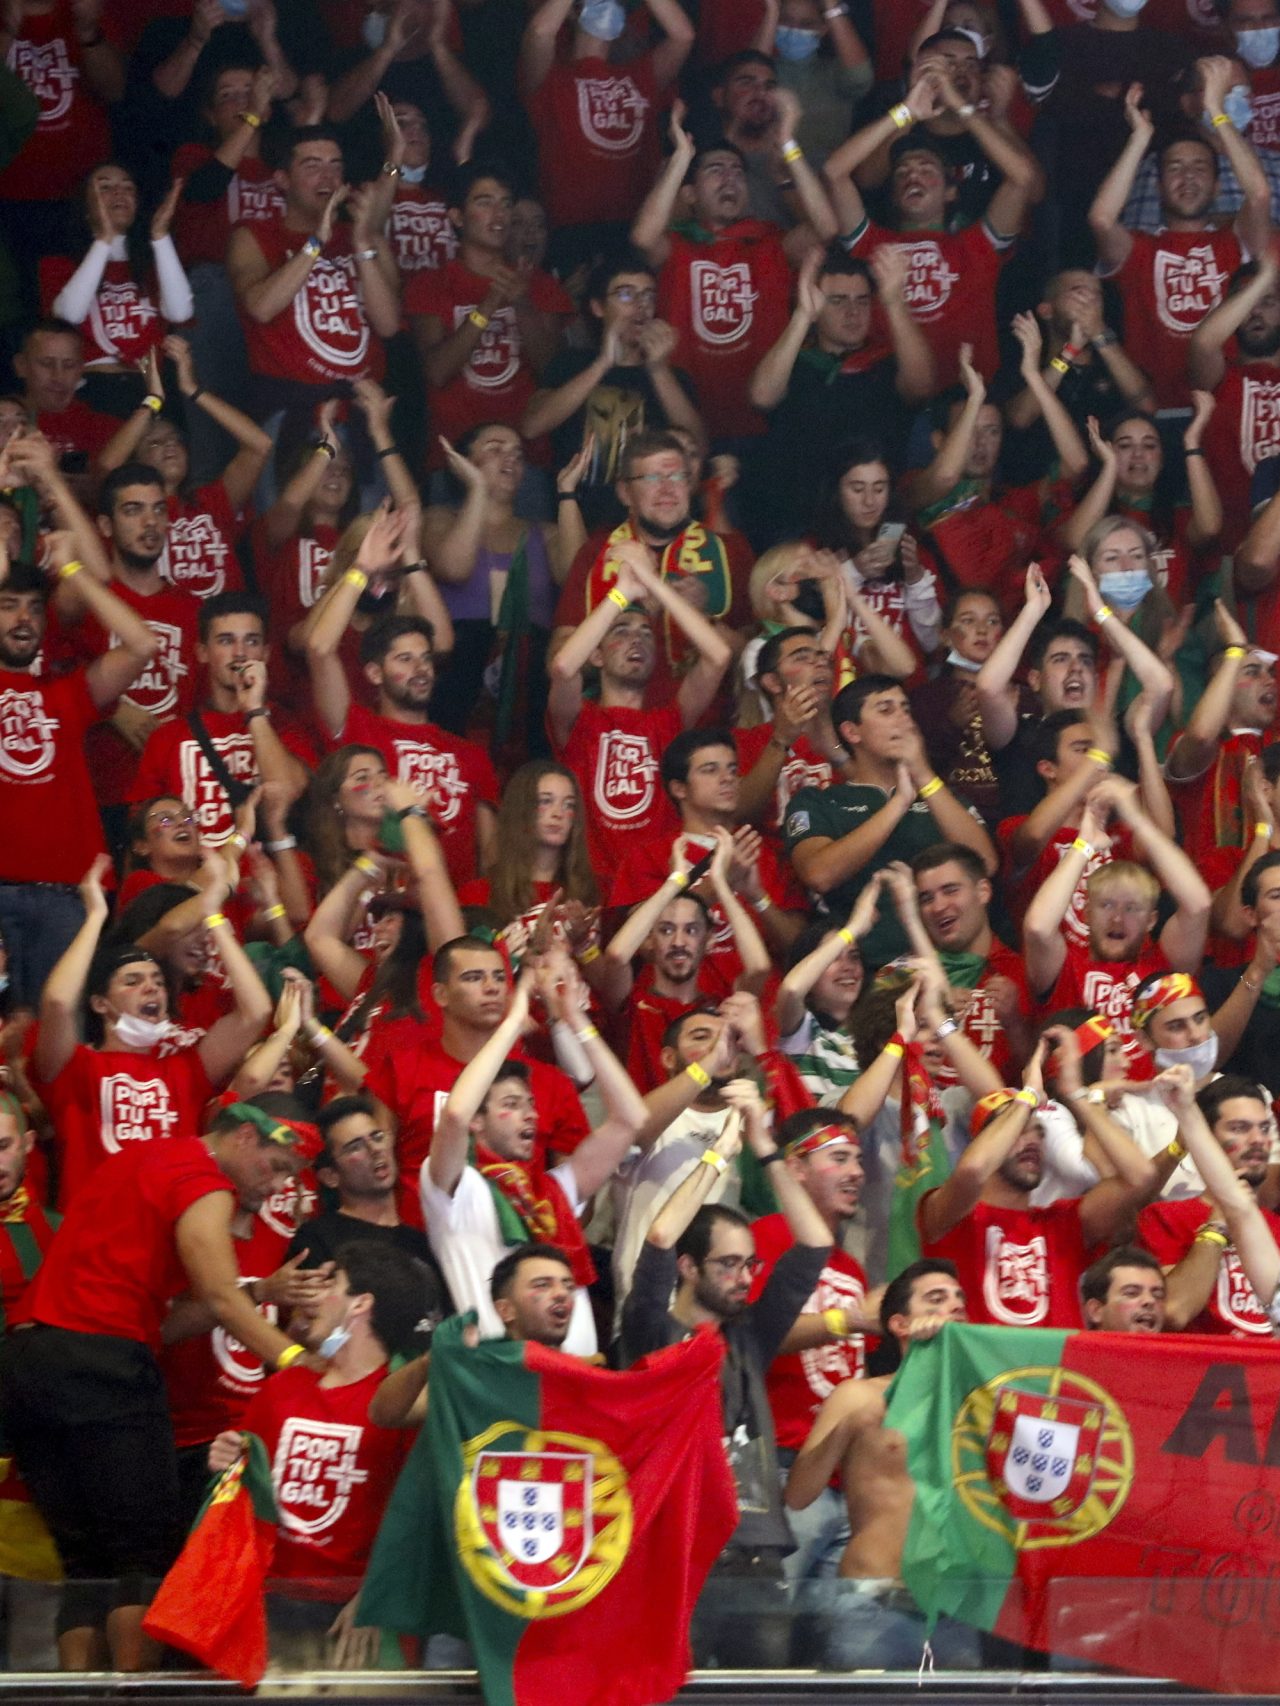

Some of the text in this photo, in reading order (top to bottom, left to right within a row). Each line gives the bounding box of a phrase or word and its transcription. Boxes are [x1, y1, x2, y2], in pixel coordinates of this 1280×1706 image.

[1168, 279, 1194, 293] TU
[702, 288, 729, 304] TU
[1167, 294, 1210, 313] GAL
[702, 306, 740, 322] GAL
[171, 544, 202, 560] TU
[606, 779, 644, 797] GAL
[116, 1104, 145, 1123] TU
[292, 1436, 342, 1461] POR
[288, 1457, 324, 1481] TU
[280, 1483, 330, 1507] GAL
